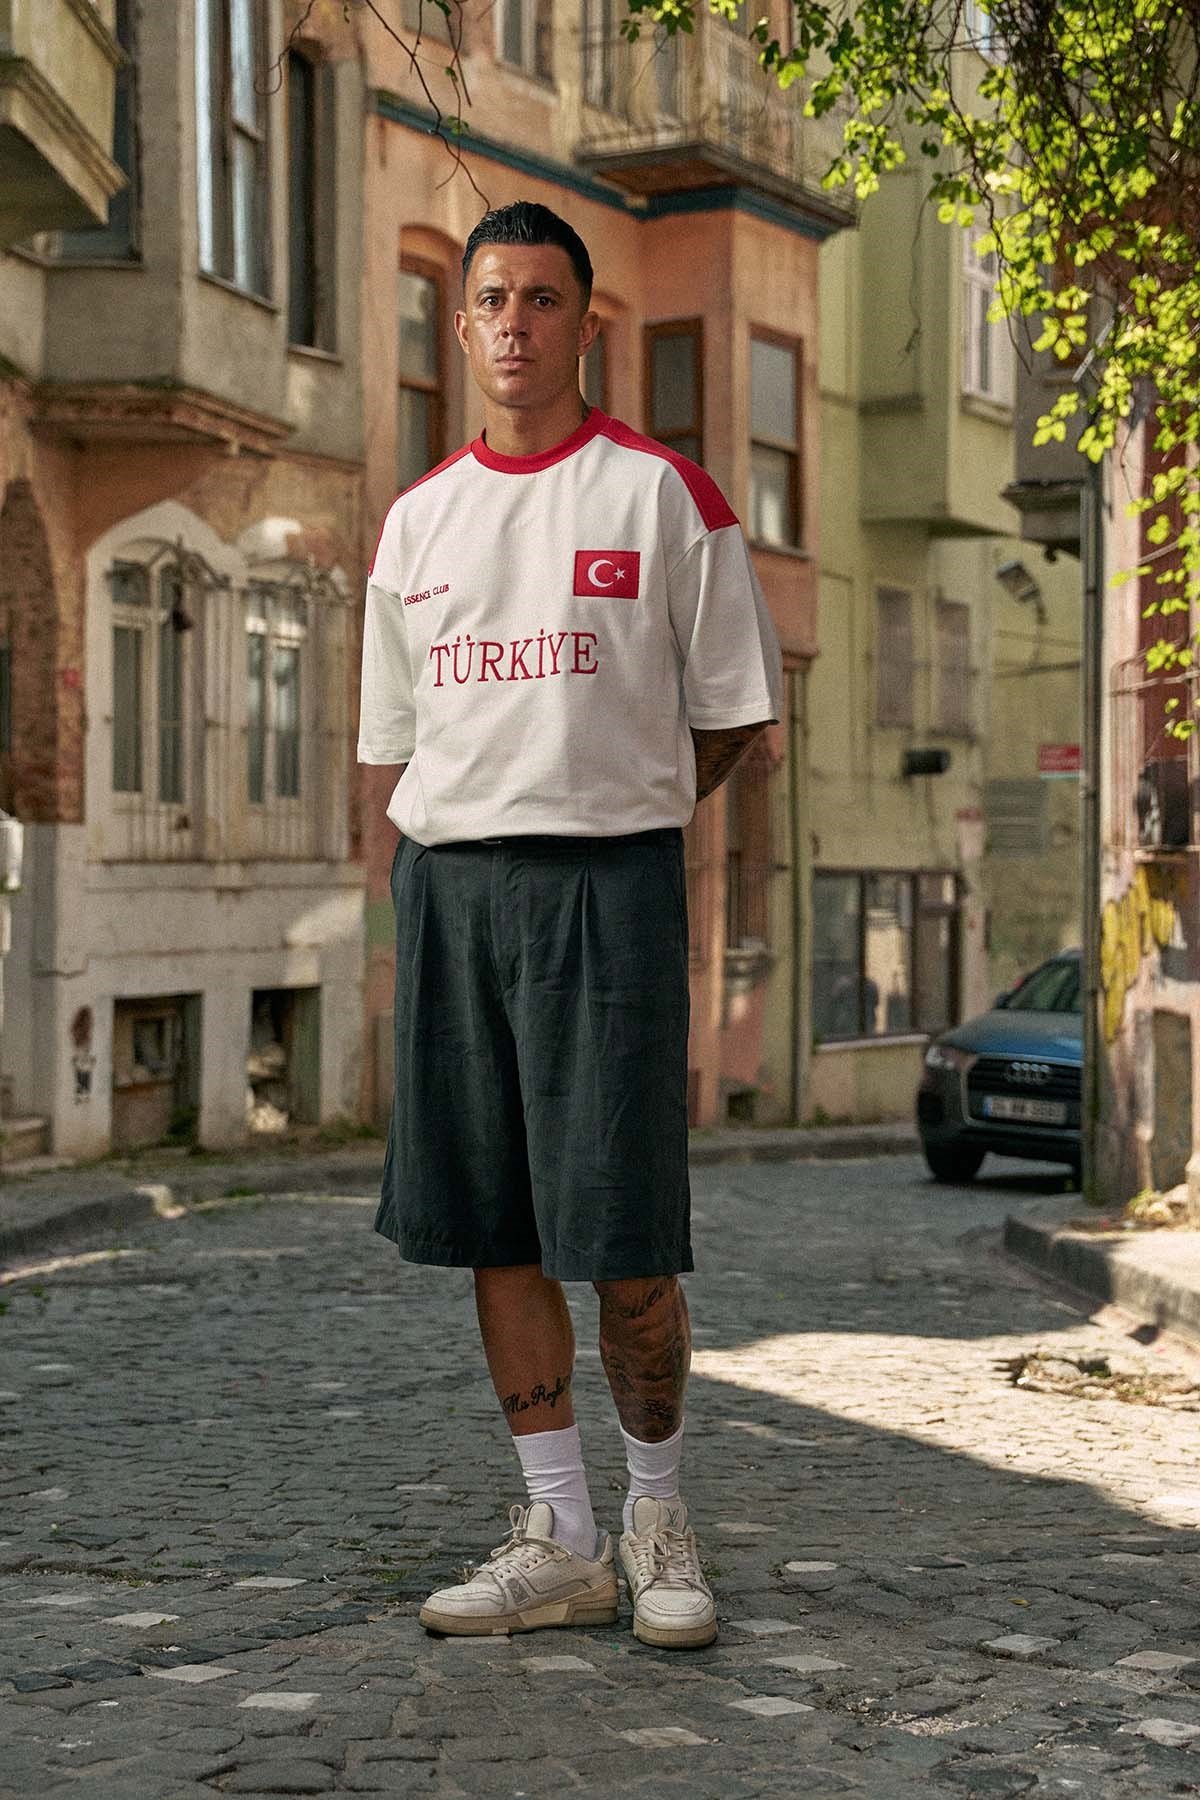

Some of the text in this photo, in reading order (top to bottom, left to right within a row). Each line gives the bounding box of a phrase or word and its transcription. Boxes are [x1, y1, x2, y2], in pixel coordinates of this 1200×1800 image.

[403, 583, 450, 606] ESSENCE CLUB
[429, 628, 599, 687] TÜRKİYE
